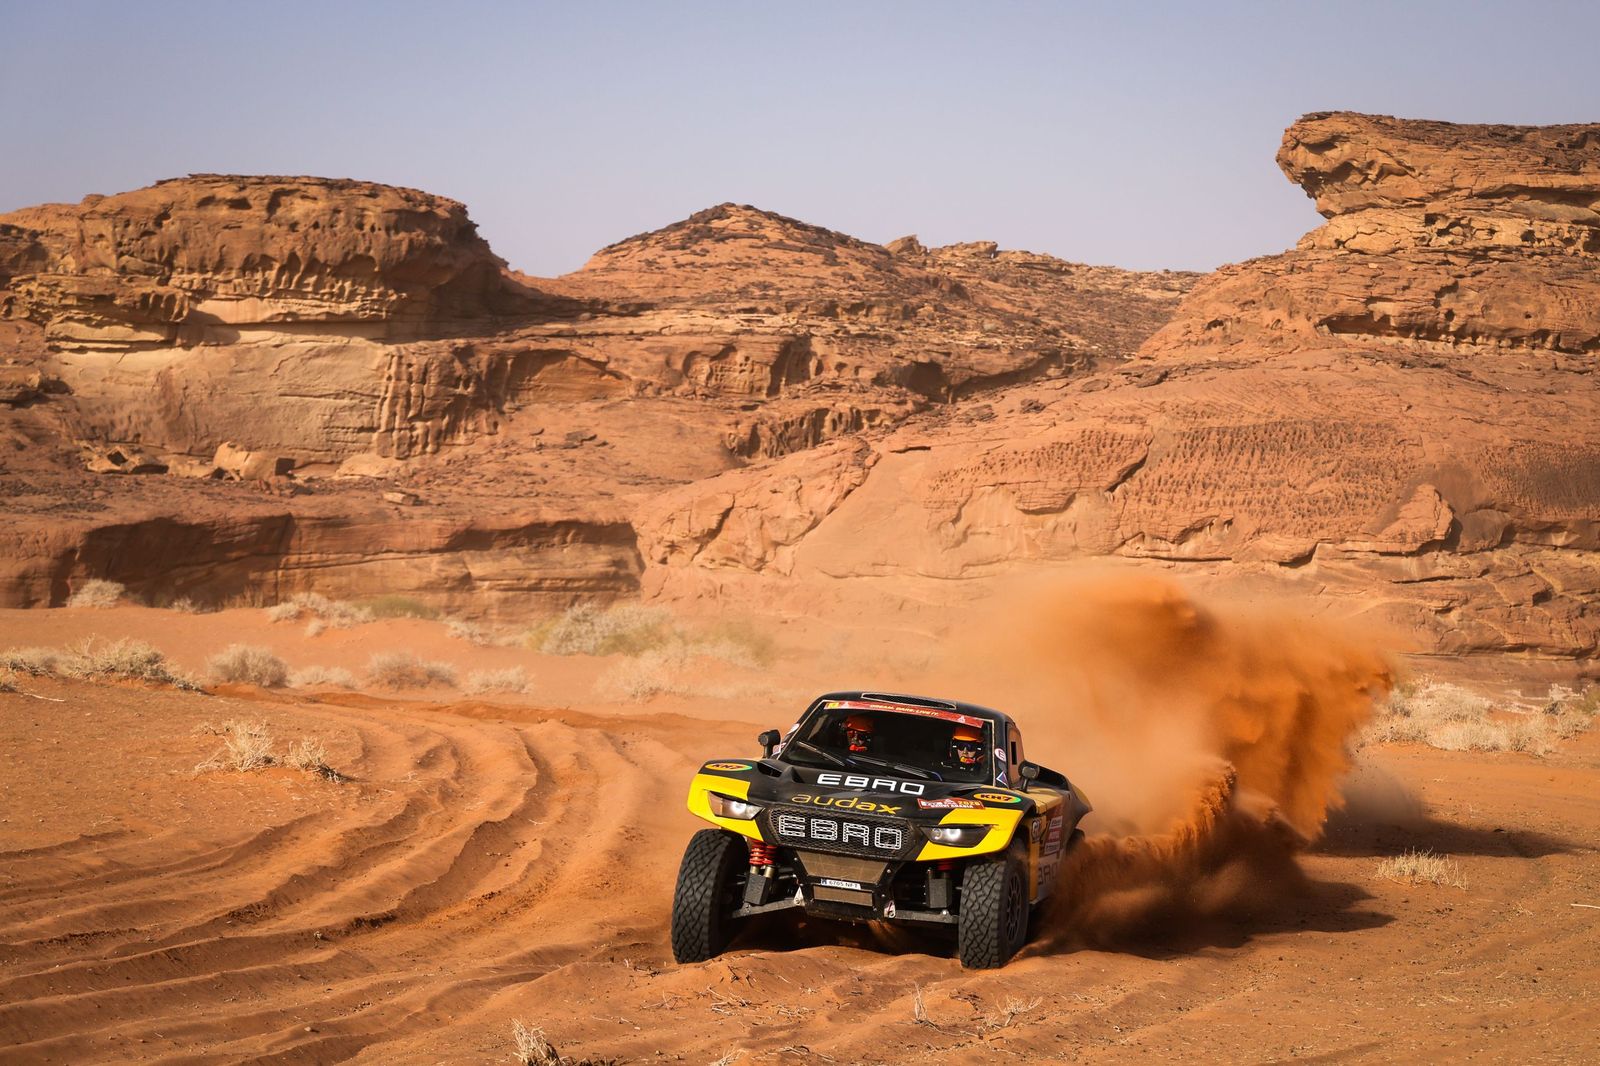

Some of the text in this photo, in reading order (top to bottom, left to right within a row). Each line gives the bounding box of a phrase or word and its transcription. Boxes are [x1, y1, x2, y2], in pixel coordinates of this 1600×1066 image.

[817, 773, 925, 796] EBRO
[791, 793, 903, 815] audax
[980, 794, 1013, 802] KH7
[778, 814, 902, 850] EBRO
